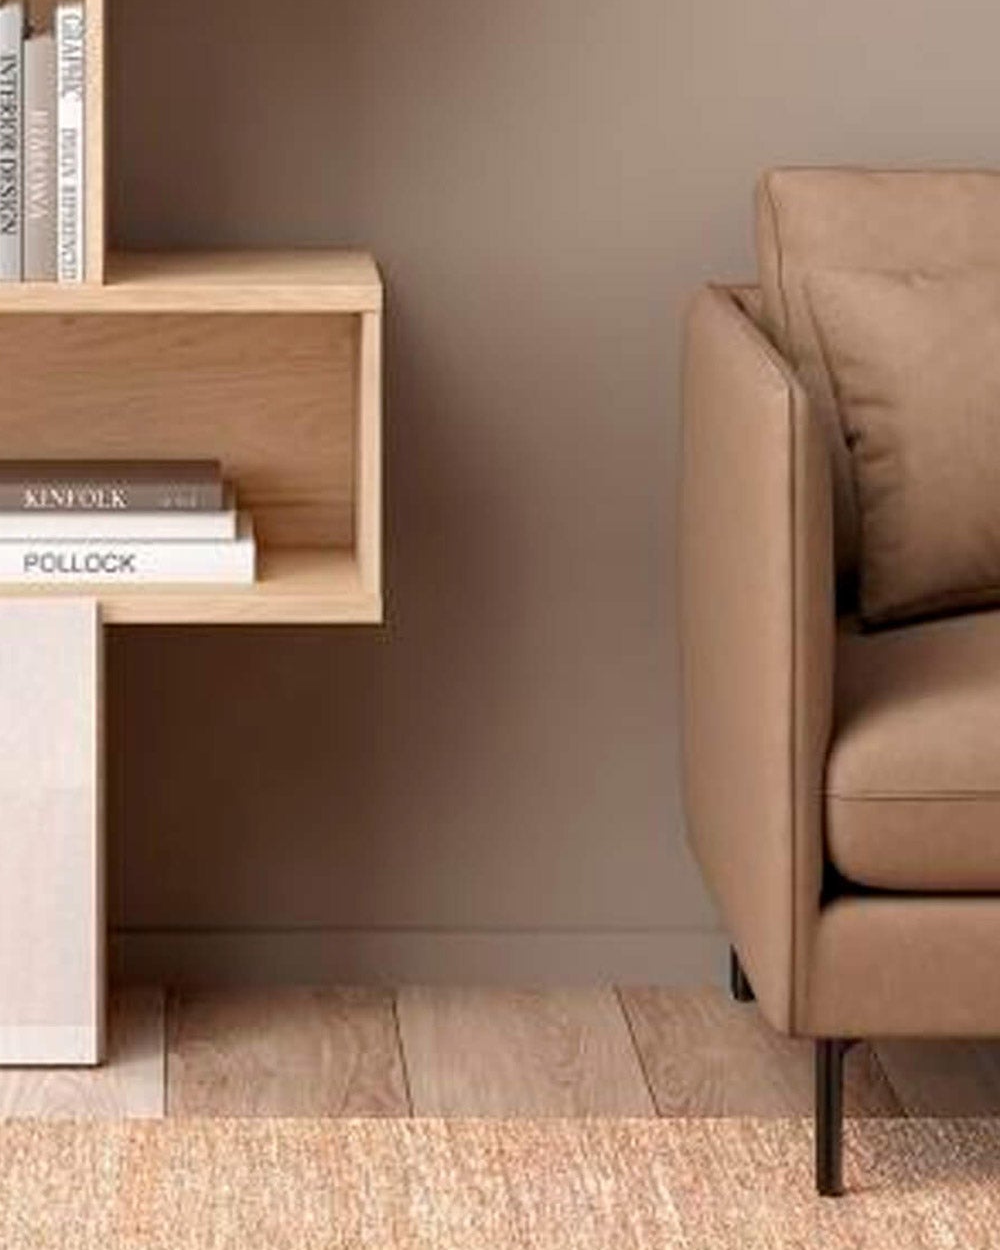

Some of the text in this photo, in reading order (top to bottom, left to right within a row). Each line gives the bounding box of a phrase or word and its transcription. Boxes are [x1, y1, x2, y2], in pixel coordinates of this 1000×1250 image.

[0, 54, 17, 236] INTERIOR DESIGN
[23, 488, 128, 509] KINFOLK
[22, 551, 138, 574] POLLOCK
